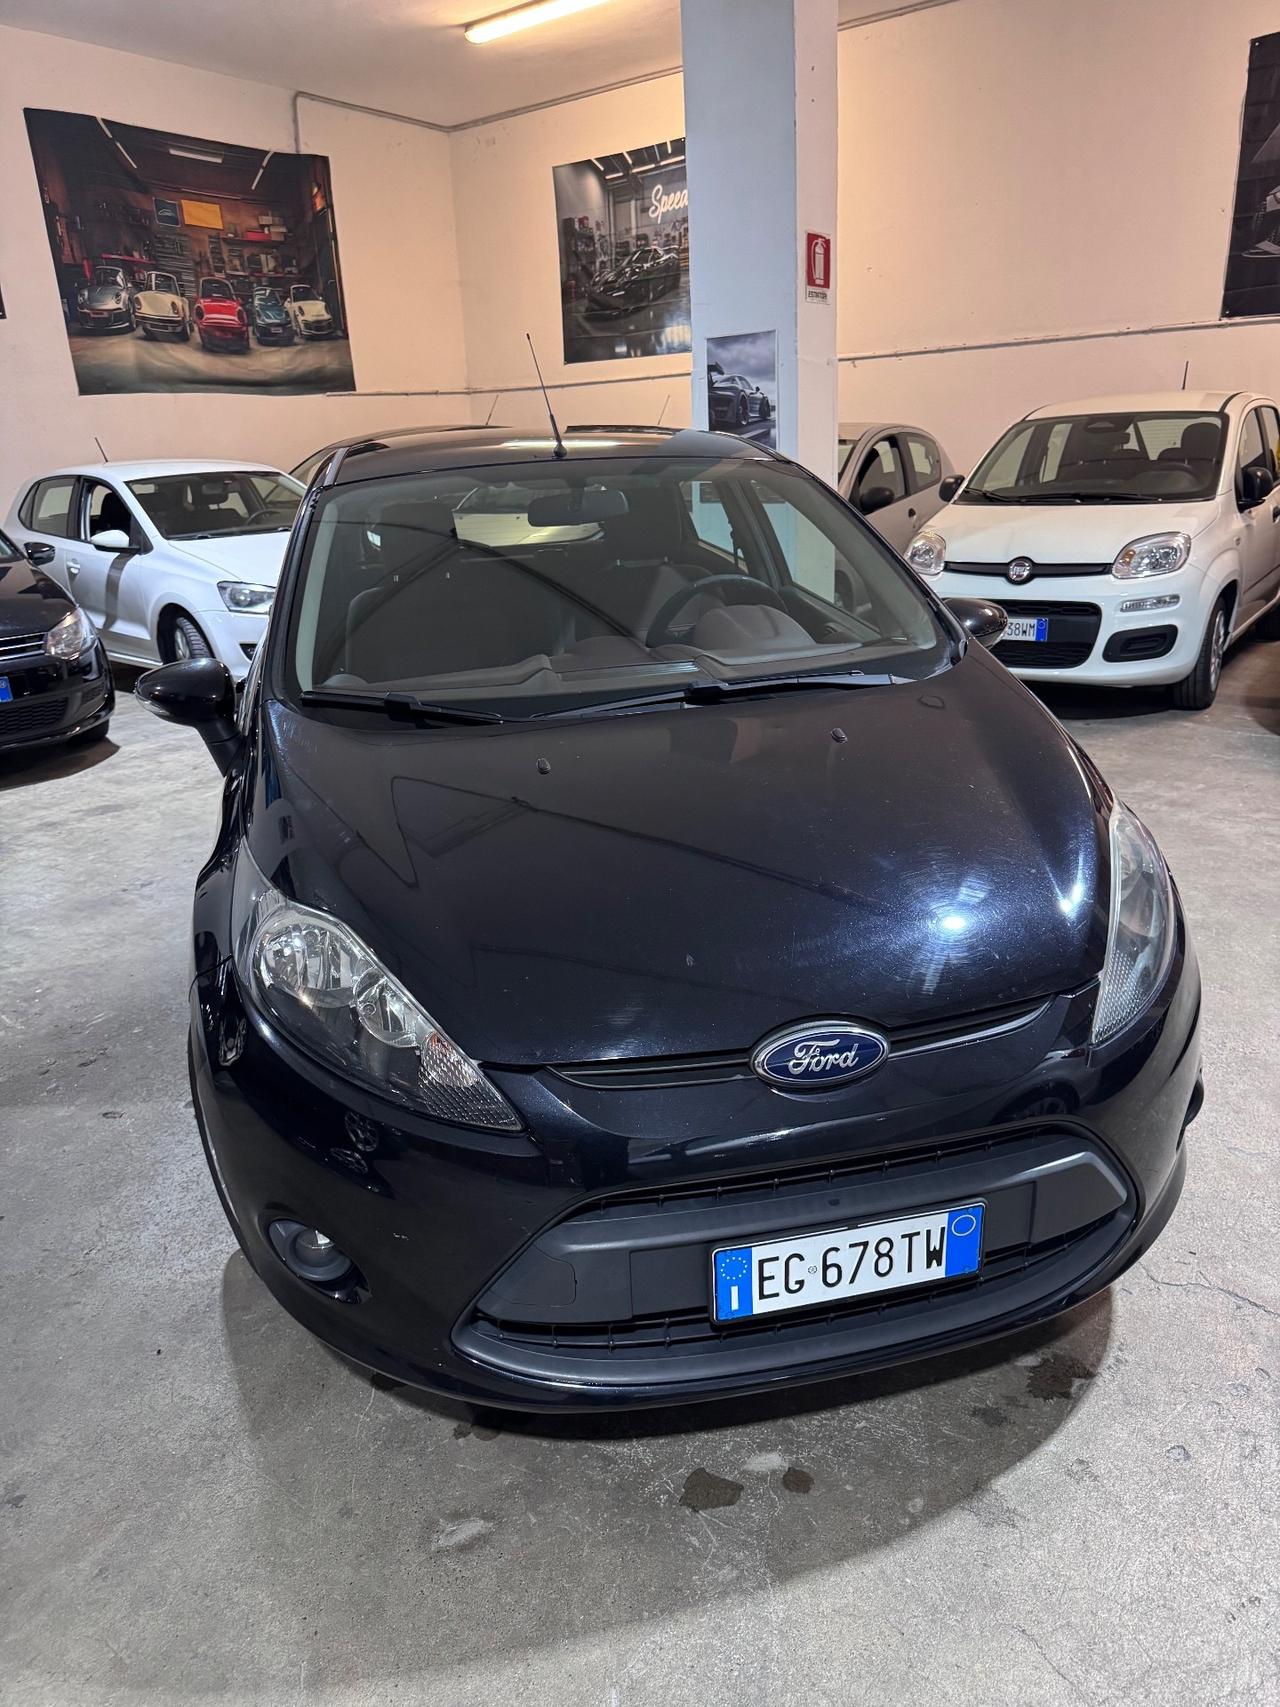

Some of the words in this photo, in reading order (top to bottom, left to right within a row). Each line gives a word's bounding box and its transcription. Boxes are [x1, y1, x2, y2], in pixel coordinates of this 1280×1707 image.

[1007, 622, 1036, 637] 38WM
[787, 1038, 859, 1075] Ford
[730, 1285, 739, 1311] I
